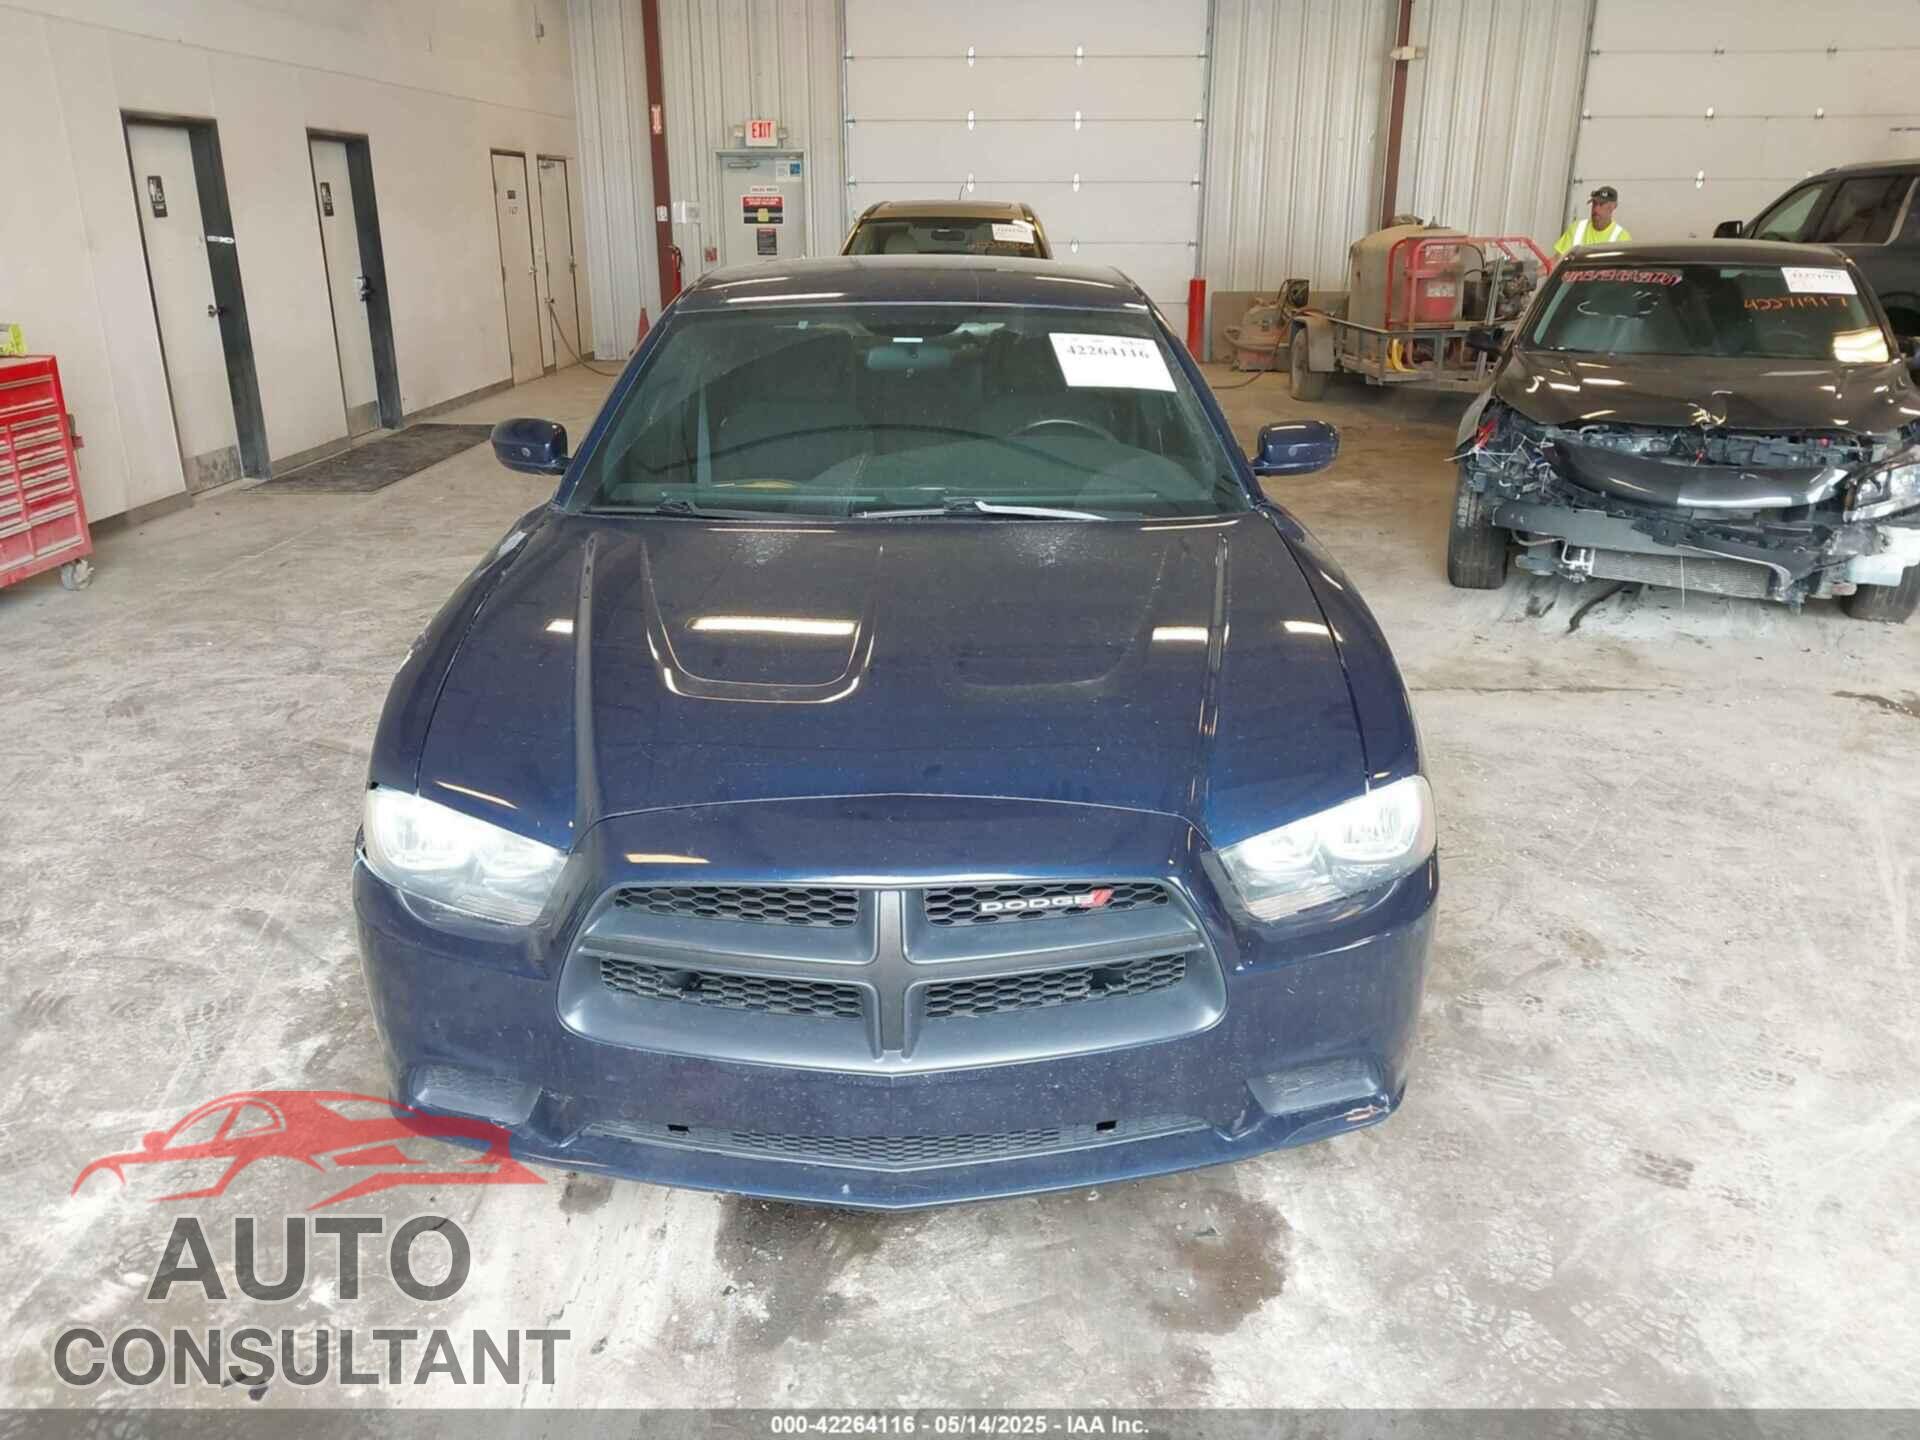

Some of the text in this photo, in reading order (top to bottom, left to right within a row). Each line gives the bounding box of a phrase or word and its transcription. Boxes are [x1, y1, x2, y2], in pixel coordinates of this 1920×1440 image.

[751, 122, 772, 138] EXIT
[1066, 344, 1150, 359] 42264116
[980, 895, 1094, 913] DODGE
